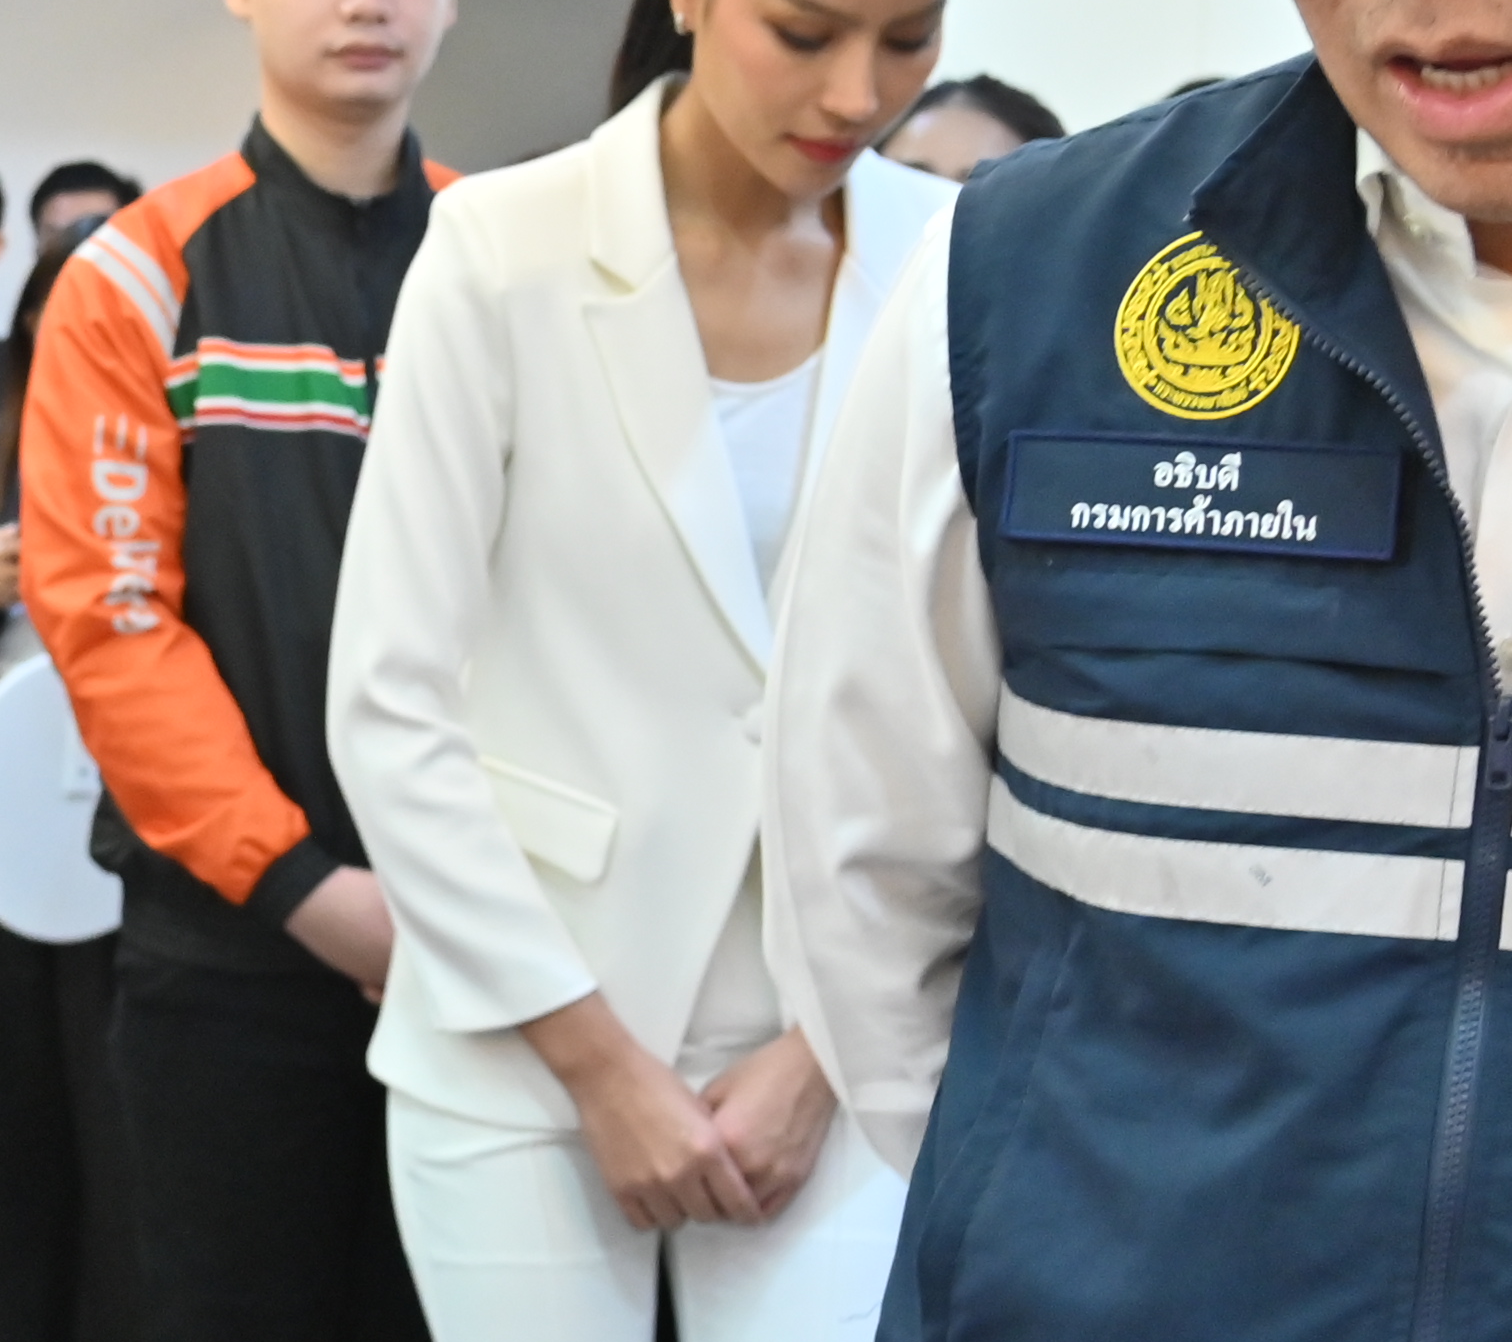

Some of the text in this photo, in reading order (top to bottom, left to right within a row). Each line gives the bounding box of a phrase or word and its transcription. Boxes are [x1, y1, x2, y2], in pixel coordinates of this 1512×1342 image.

[1153, 450, 1243, 491] อธิบดี
[1070, 493, 1319, 542] กรมการค้าภายใน
